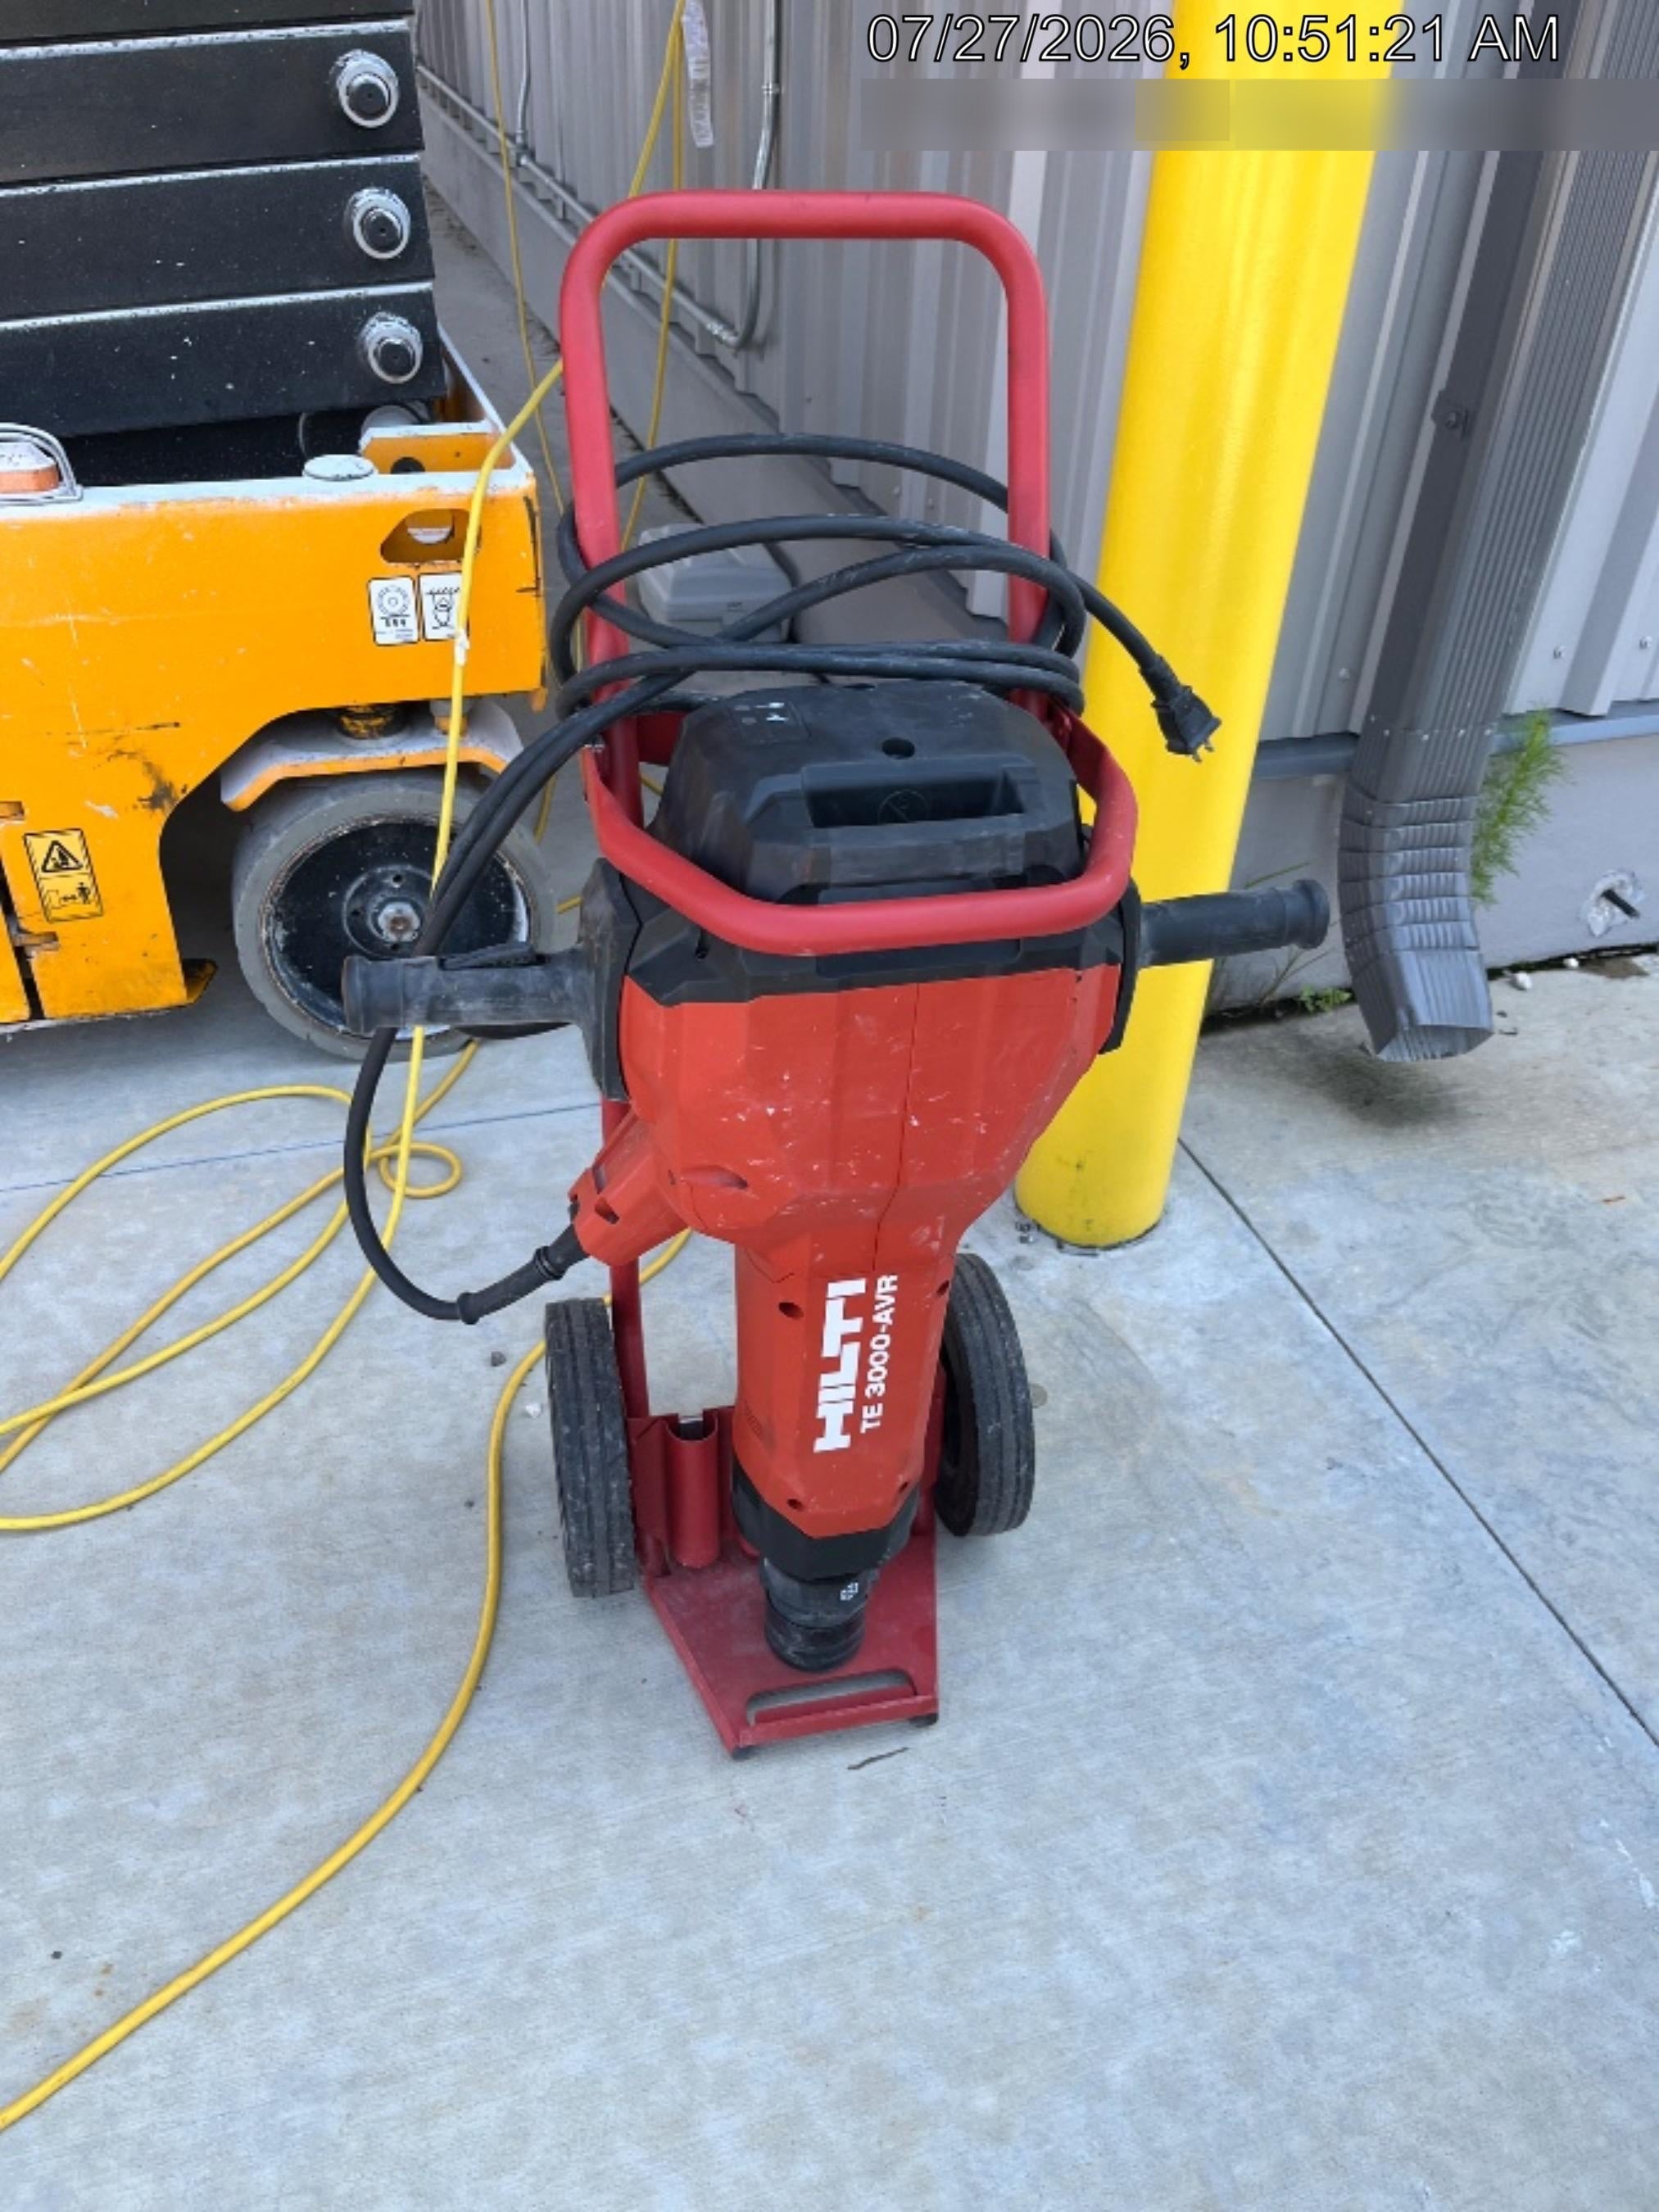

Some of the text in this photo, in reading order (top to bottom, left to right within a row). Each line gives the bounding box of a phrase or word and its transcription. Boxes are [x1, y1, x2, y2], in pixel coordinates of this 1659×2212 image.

[813, 1277, 866, 1453] HILTI
[859, 1274, 899, 1434] TE 3000-AVR
